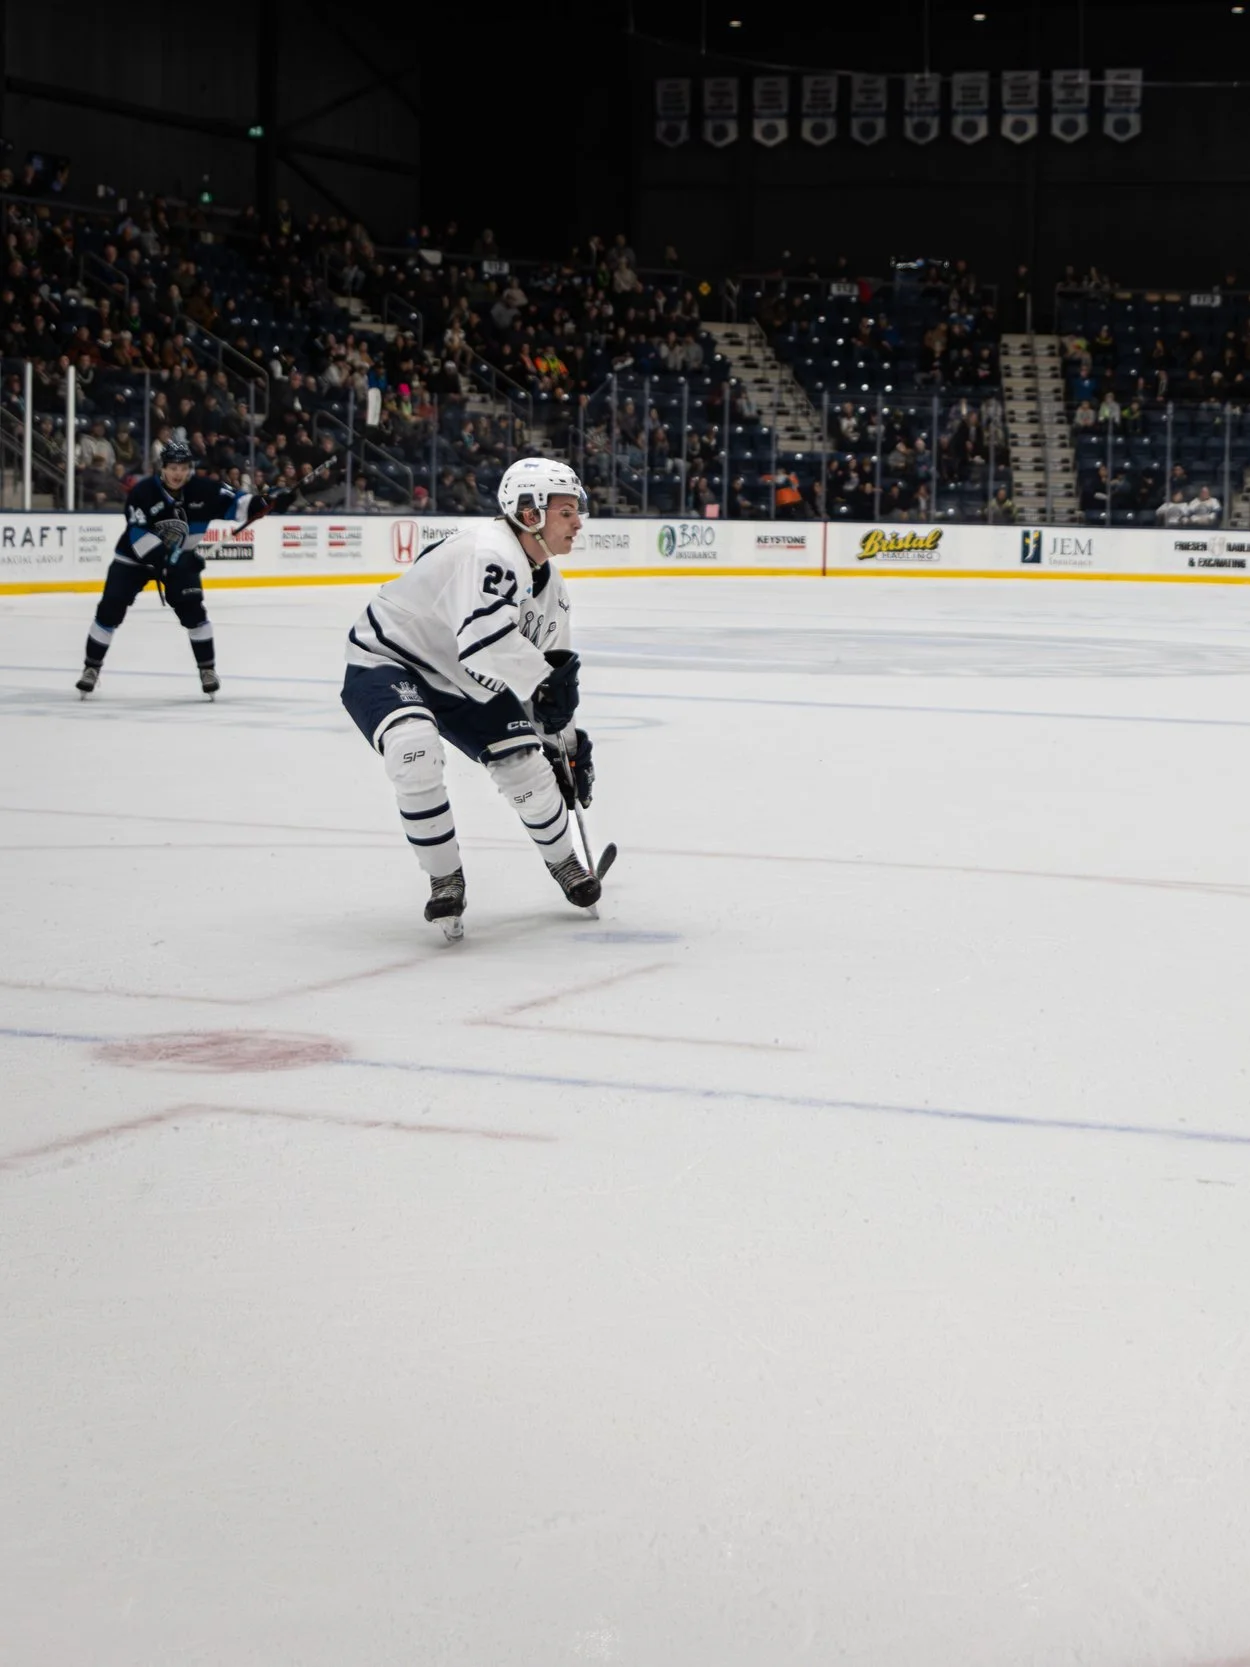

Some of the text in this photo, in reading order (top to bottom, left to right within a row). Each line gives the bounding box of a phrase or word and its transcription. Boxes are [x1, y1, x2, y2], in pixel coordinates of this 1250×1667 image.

[588, 534, 630, 549] TRISTAR
[677, 524, 716, 548] BRIO
[756, 535, 807, 544] KEYSTONE
[1049, 537, 1094, 556] JEM
[881, 552, 935, 560] HAULING
[508, 720, 533, 730] CC
[402, 750, 426, 764] SP
[513, 791, 533, 804] SP
